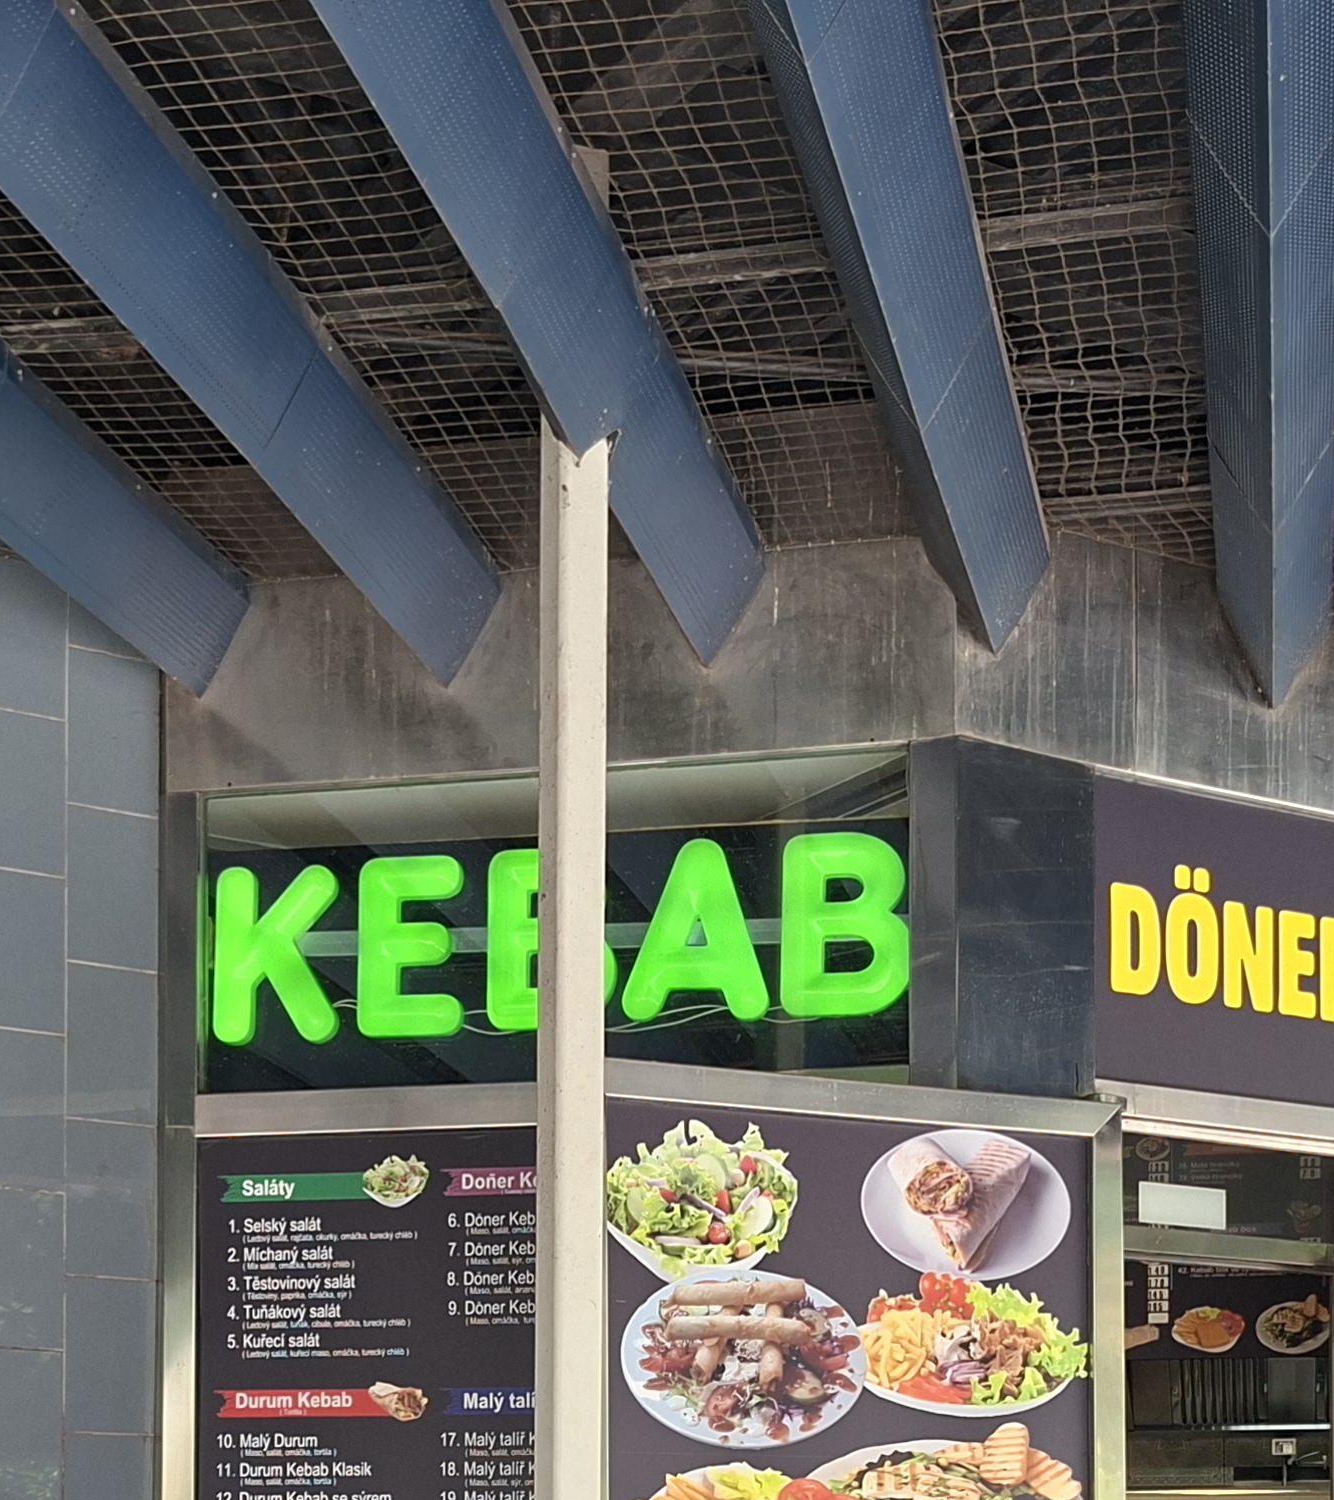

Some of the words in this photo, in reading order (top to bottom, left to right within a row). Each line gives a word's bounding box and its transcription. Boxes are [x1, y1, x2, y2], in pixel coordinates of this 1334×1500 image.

[242, 1179, 295, 1199] Saláty
[229, 1220, 240, 1233] 1.
[244, 1218, 286, 1235] Selský
[290, 1217, 321, 1232] salát
[448, 1213, 460, 1227] 6.
[465, 1212, 505, 1227] Döner
[228, 1248, 239, 1262] 2.
[244, 1247, 298, 1263] Míchaný
[302, 1246, 333, 1260] salát
[448, 1243, 460, 1257] 7.
[465, 1242, 505, 1256] Döner
[228, 1277, 239, 1291] 3.
[243, 1275, 320, 1292] Těstovinový
[324, 1274, 355, 1289] salát
[447, 1272, 459, 1286] 8.
[464, 1271, 504, 1286] Döner
[508, 1270, 536, 1285] Keb
[227, 1306, 239, 1320] 4.
[243, 1304, 306, 1321] Tuňákový
[310, 1304, 341, 1318] salát
[448, 1301, 460, 1315] 9.
[465, 1301, 505, 1315] Döner
[227, 1335, 239, 1348] 5.
[243, 1333, 284, 1348] Kuřecí
[289, 1333, 320, 1347] salát
[236, 1393, 292, 1408] Durum
[298, 1392, 352, 1408] Kebab
[464, 1392, 503, 1413] Malý
[217, 1434, 236, 1448] 10.
[240, 1434, 270, 1451] Malý
[274, 1433, 317, 1448] Durum
[440, 1432, 460, 1447] 17.
[465, 1432, 496, 1450] Malý
[500, 1432, 525, 1446] talíř
[217, 1464, 235, 1477] 11.
[240, 1463, 282, 1477] Durum
[287, 1463, 328, 1476] Kebab
[333, 1462, 371, 1476] Klasik
[440, 1462, 459, 1476] 18.
[464, 1461, 495, 1479] Malý
[500, 1461, 525, 1476] talíř
